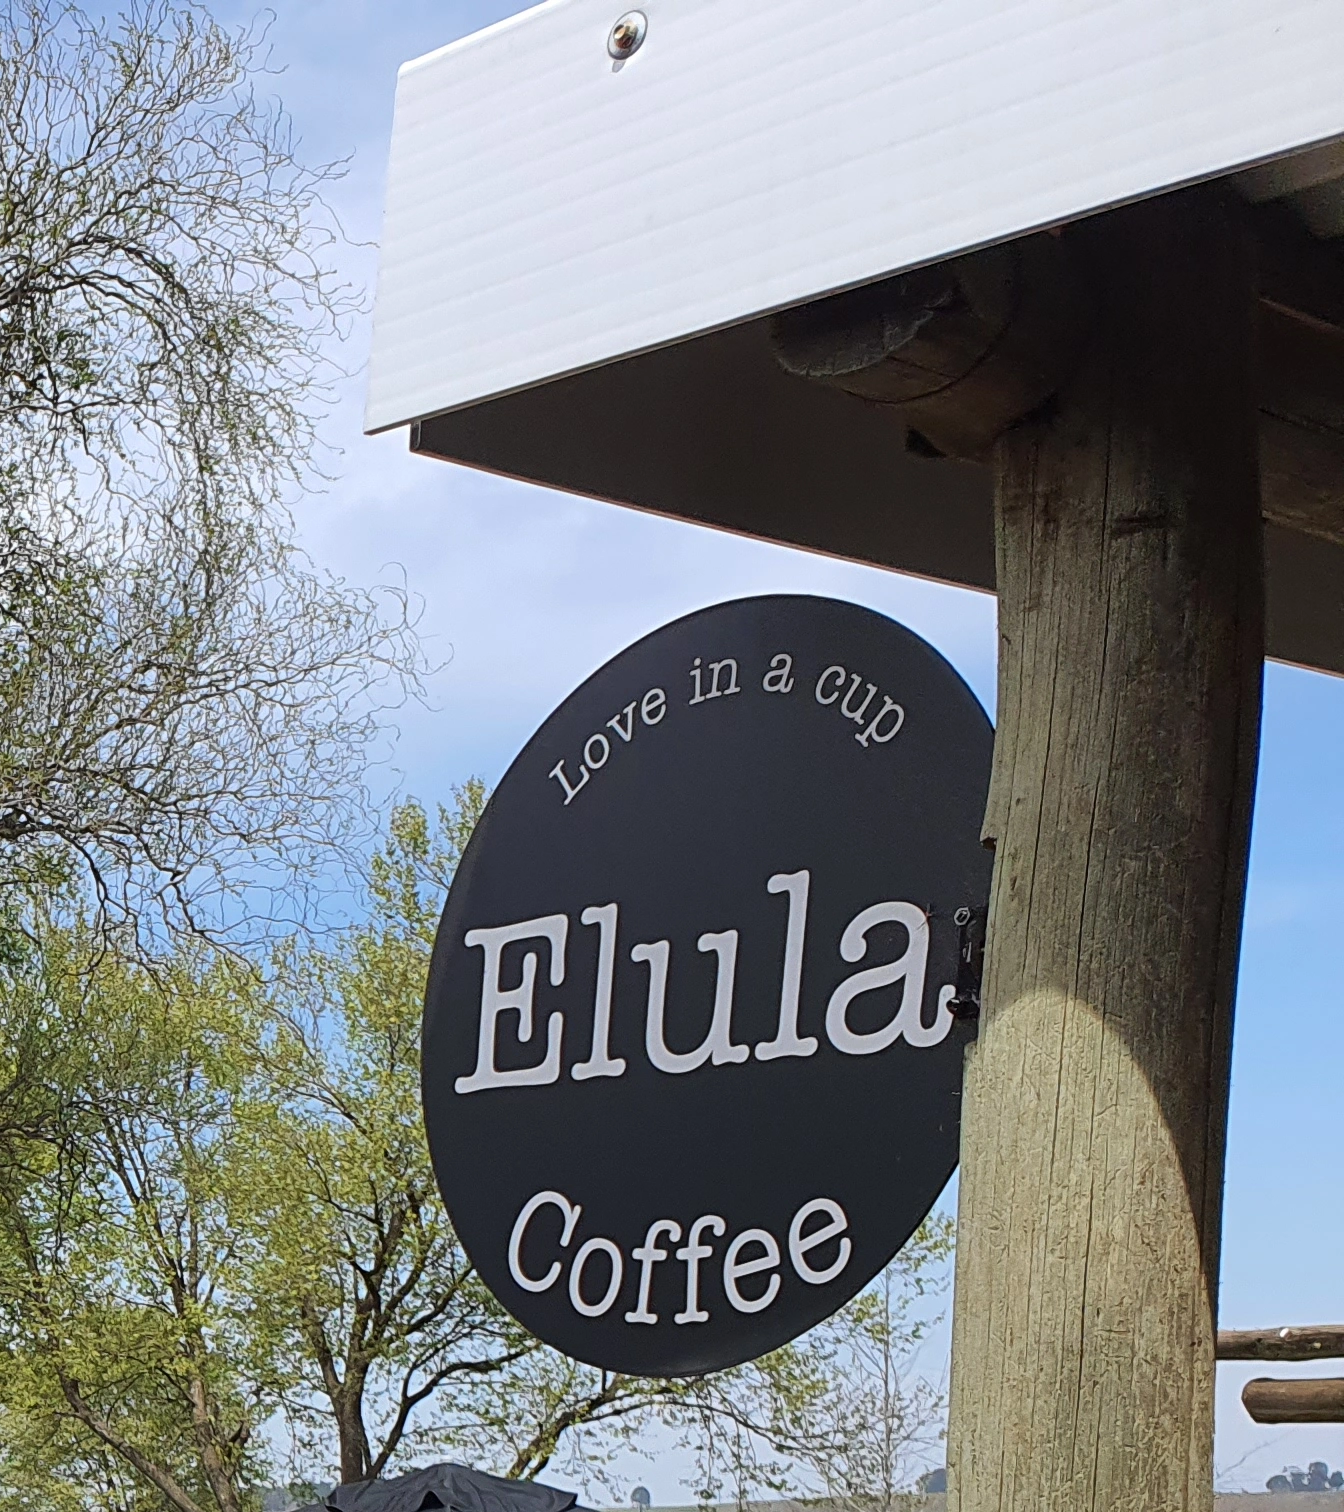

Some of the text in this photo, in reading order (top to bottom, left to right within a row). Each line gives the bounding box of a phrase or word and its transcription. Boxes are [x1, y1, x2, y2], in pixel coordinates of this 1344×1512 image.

[548, 652, 907, 806] Love in a cup
[453, 868, 957, 1096] Elula
[507, 1190, 852, 1326] Coffee
